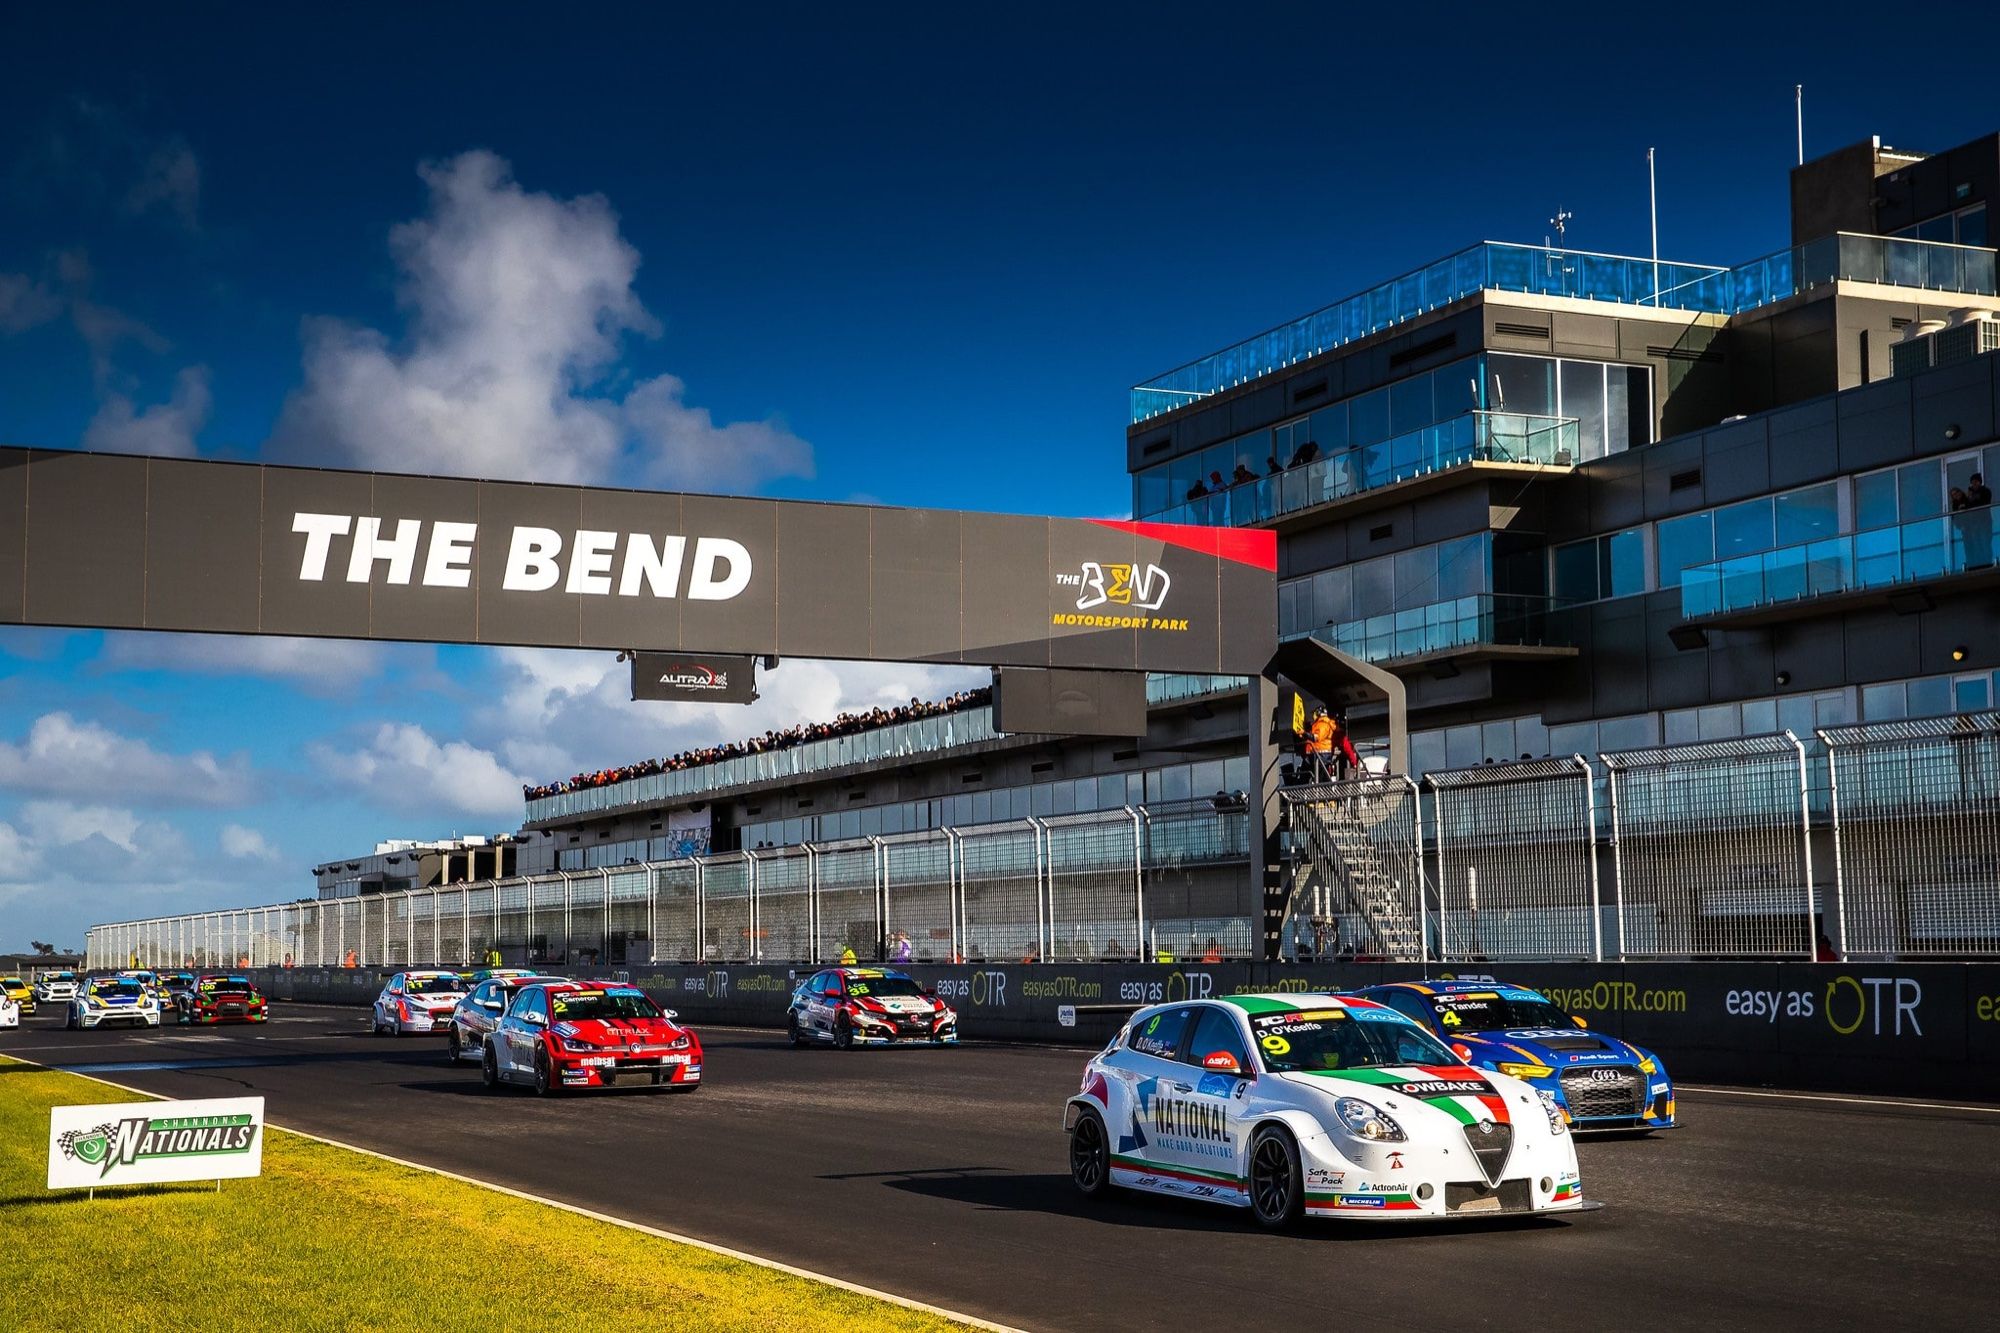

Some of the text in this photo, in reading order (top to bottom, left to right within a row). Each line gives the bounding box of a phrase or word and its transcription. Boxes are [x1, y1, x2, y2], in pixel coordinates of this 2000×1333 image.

[292, 512, 753, 600] THE BEND
[1056, 562, 1171, 610] THE BEND
[1053, 614, 1189, 631] MOTORSPORT PARK
[684, 970, 729, 998] easy as OTR
[737, 974, 785, 994] easyasOTR.com
[849, 986, 870, 997] 38
[937, 977, 958, 999] easy
[958, 978, 969, 995] as
[972, 970, 1006, 1006] OTR
[1023, 976, 1101, 1000] easyasOTR.com
[1120, 971, 1213, 1003] easy as OTR
[562, 995, 598, 1003] Cameron
[1433, 993, 1469, 1003] TCR
[1534, 981, 1685, 1013] asyasOTR.com
[1726, 975, 1923, 1037] easy as OTR
[553, 1002, 568, 1013] 2
[1434, 1002, 1489, 1013] G. Tander
[1146, 1015, 1161, 1035] 9
[1254, 1014, 1304, 1027] TCR
[1442, 1010, 1462, 1026] 4
[1256, 1022, 1322, 1039] D. O'Keeffe
[1262, 1035, 1291, 1055] 9
[1235, 1082, 1247, 1100] 9
[162, 1115, 238, 1129] SHANNONS
[1155, 1097, 1231, 1143] NATIONAL
[119, 1119, 251, 1162] NATIONALS
[1156, 1137, 1233, 1159] MAKE GOOD SOLUTIONS
[1308, 1168, 1328, 1177] Safe
[1321, 1177, 1344, 1185] Pack
[1371, 1182, 1408, 1192] ActronAir
